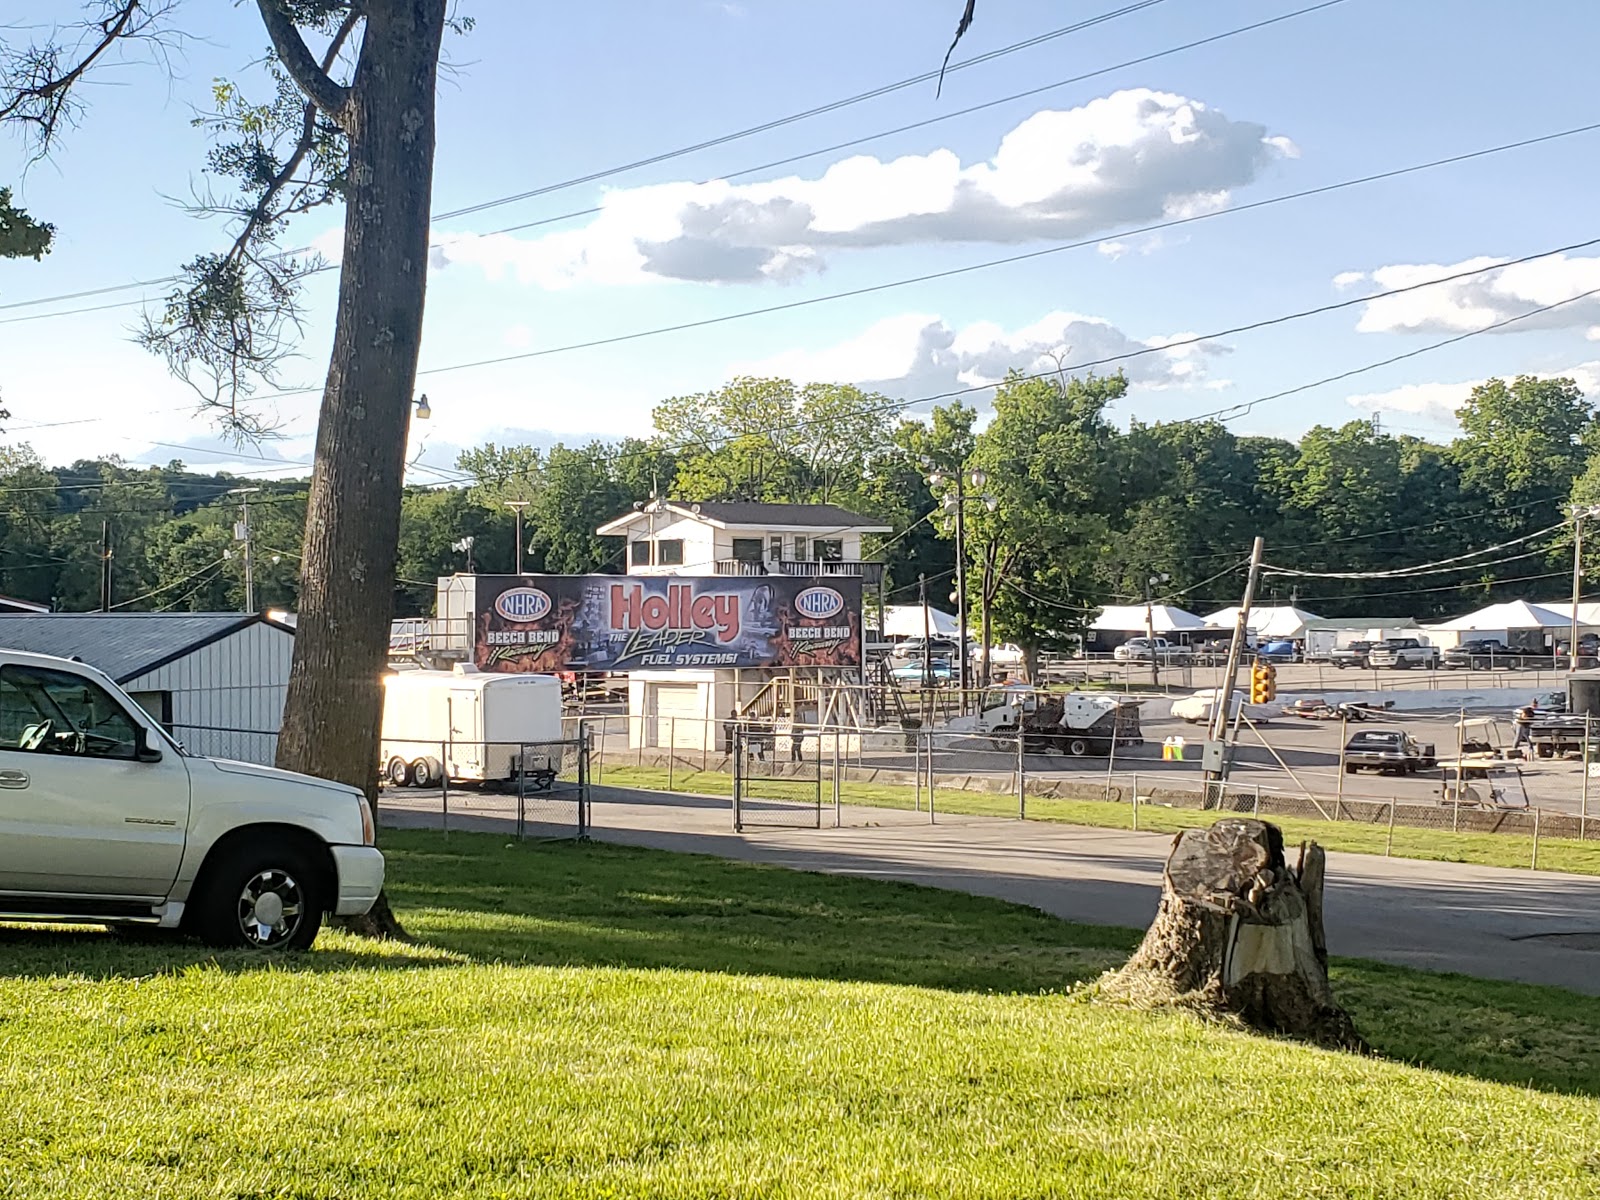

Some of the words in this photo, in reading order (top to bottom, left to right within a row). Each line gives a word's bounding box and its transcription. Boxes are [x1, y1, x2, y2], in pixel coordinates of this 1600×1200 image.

[505, 594, 543, 614] NHRA
[803, 593, 836, 612] NHRA
[611, 585, 740, 643] Holley
[488, 631, 525, 644] BEECH
[528, 630, 560, 643] BEND
[609, 633, 628, 642] THE
[789, 627, 820, 638] BEECH
[824, 627, 850, 638] BEND
[665, 645, 677, 654] IN
[641, 653, 672, 666] FUEL
[675, 652, 738, 665] SYSTEMS!
